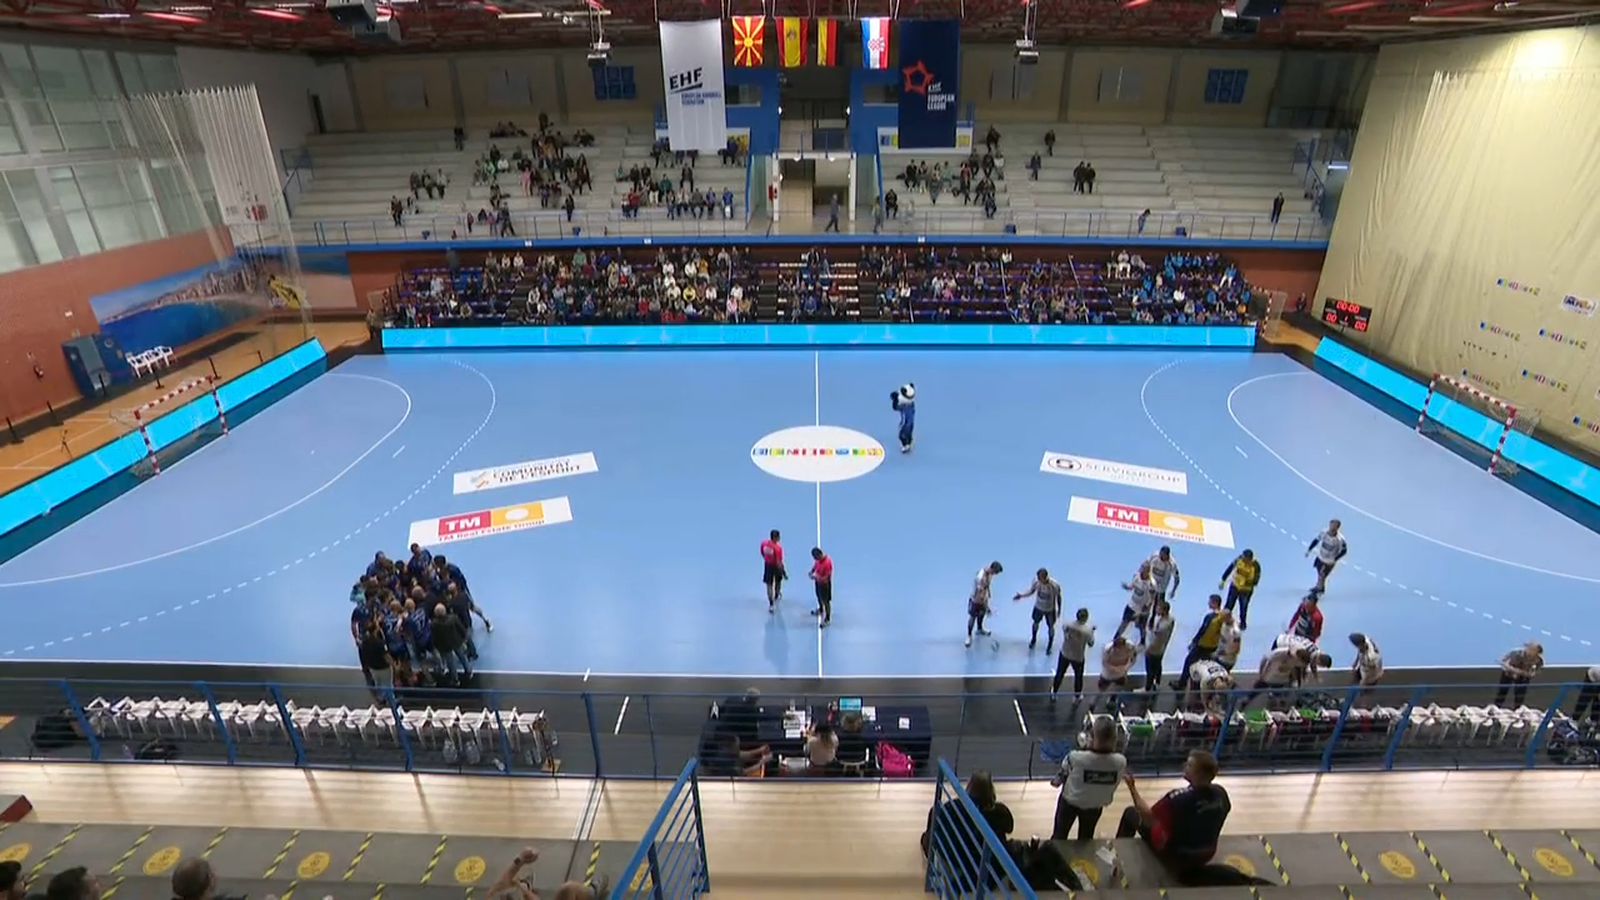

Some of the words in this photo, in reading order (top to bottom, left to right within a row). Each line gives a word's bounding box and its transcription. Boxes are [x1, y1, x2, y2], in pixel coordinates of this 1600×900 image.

[669, 66, 702, 90] EHF
[1104, 506, 1139, 523] TM
[445, 516, 481, 532] TM
